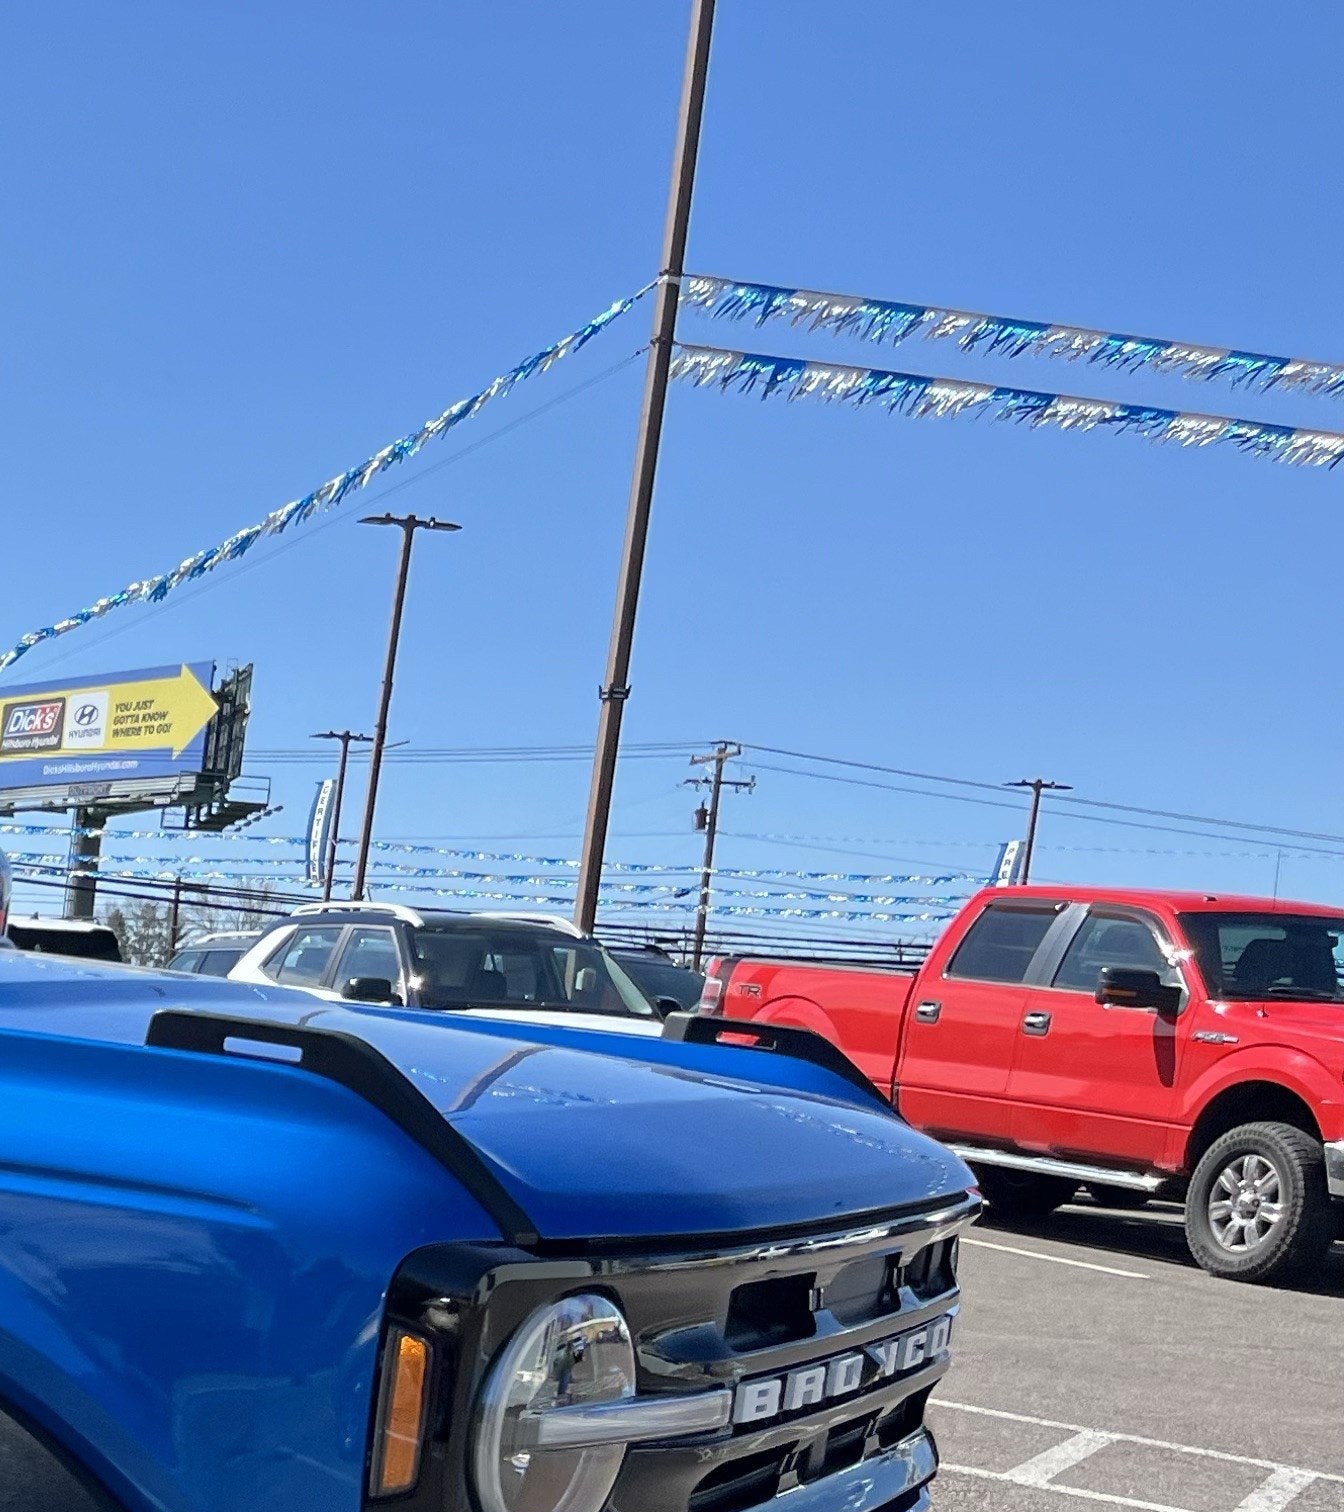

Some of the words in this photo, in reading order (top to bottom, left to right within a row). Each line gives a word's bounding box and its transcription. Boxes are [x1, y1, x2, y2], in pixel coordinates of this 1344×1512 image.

[115, 702, 133, 713] YOU
[133, 700, 154, 711] JUST
[8, 708, 55, 733] Dick's
[113, 714, 140, 726] GOTTA
[141, 711, 169, 723] KNOW
[68, 728, 101, 739] HYUNDAI
[112, 727, 142, 738] WHERE
[143, 725, 155, 736] TO
[733, 1316, 952, 1424] BRONCO
